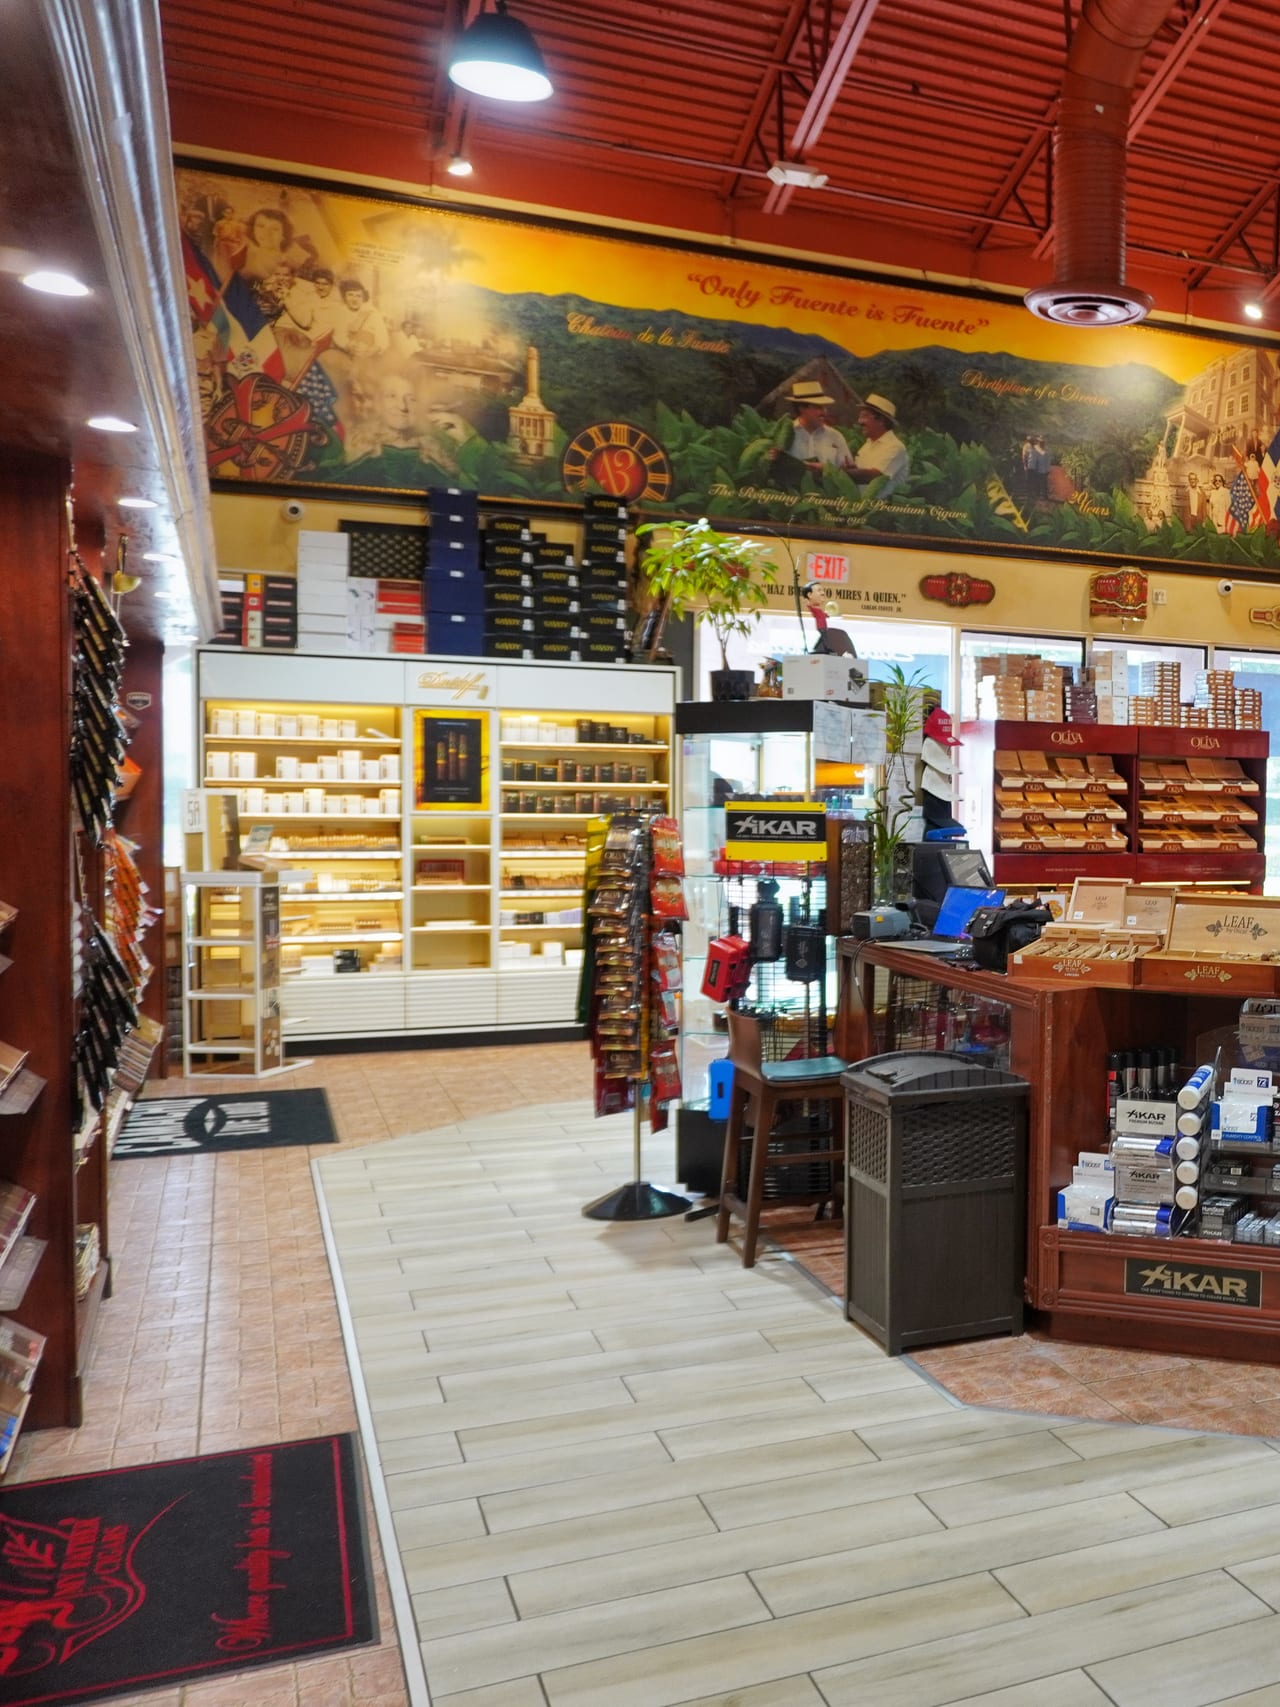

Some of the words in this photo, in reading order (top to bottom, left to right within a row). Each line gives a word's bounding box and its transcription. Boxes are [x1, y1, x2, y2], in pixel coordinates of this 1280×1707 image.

[769, 285, 859, 318] Fuente
[866, 303, 884, 320] is
[658, 326, 673, 346] la
[678, 329, 729, 354] Fuente
[960, 369, 1031, 395] Birthplace
[1034, 380, 1046, 399] of
[1047, 388, 1057, 398] a
[1061, 384, 1109, 406] Dream
[708, 483, 736, 498] The
[739, 485, 799, 505] Reigning
[800, 493, 849, 511] Family
[851, 498, 865, 513] of
[865, 499, 924, 516] Premium
[929, 505, 967, 520] Cigars
[814, 555, 845, 580] EXIT
[835, 590, 862, 601] MIRES
[864, 592, 870, 601] A
[1223, 915, 1254, 928] LEAF
[1063, 959, 1082, 968] LEAF
[1197, 966, 1220, 975] LEAF
[251, 1509, 272, 1525] no
[234, 1526, 272, 1549] has
[210, 1594, 272, 1651] Where
